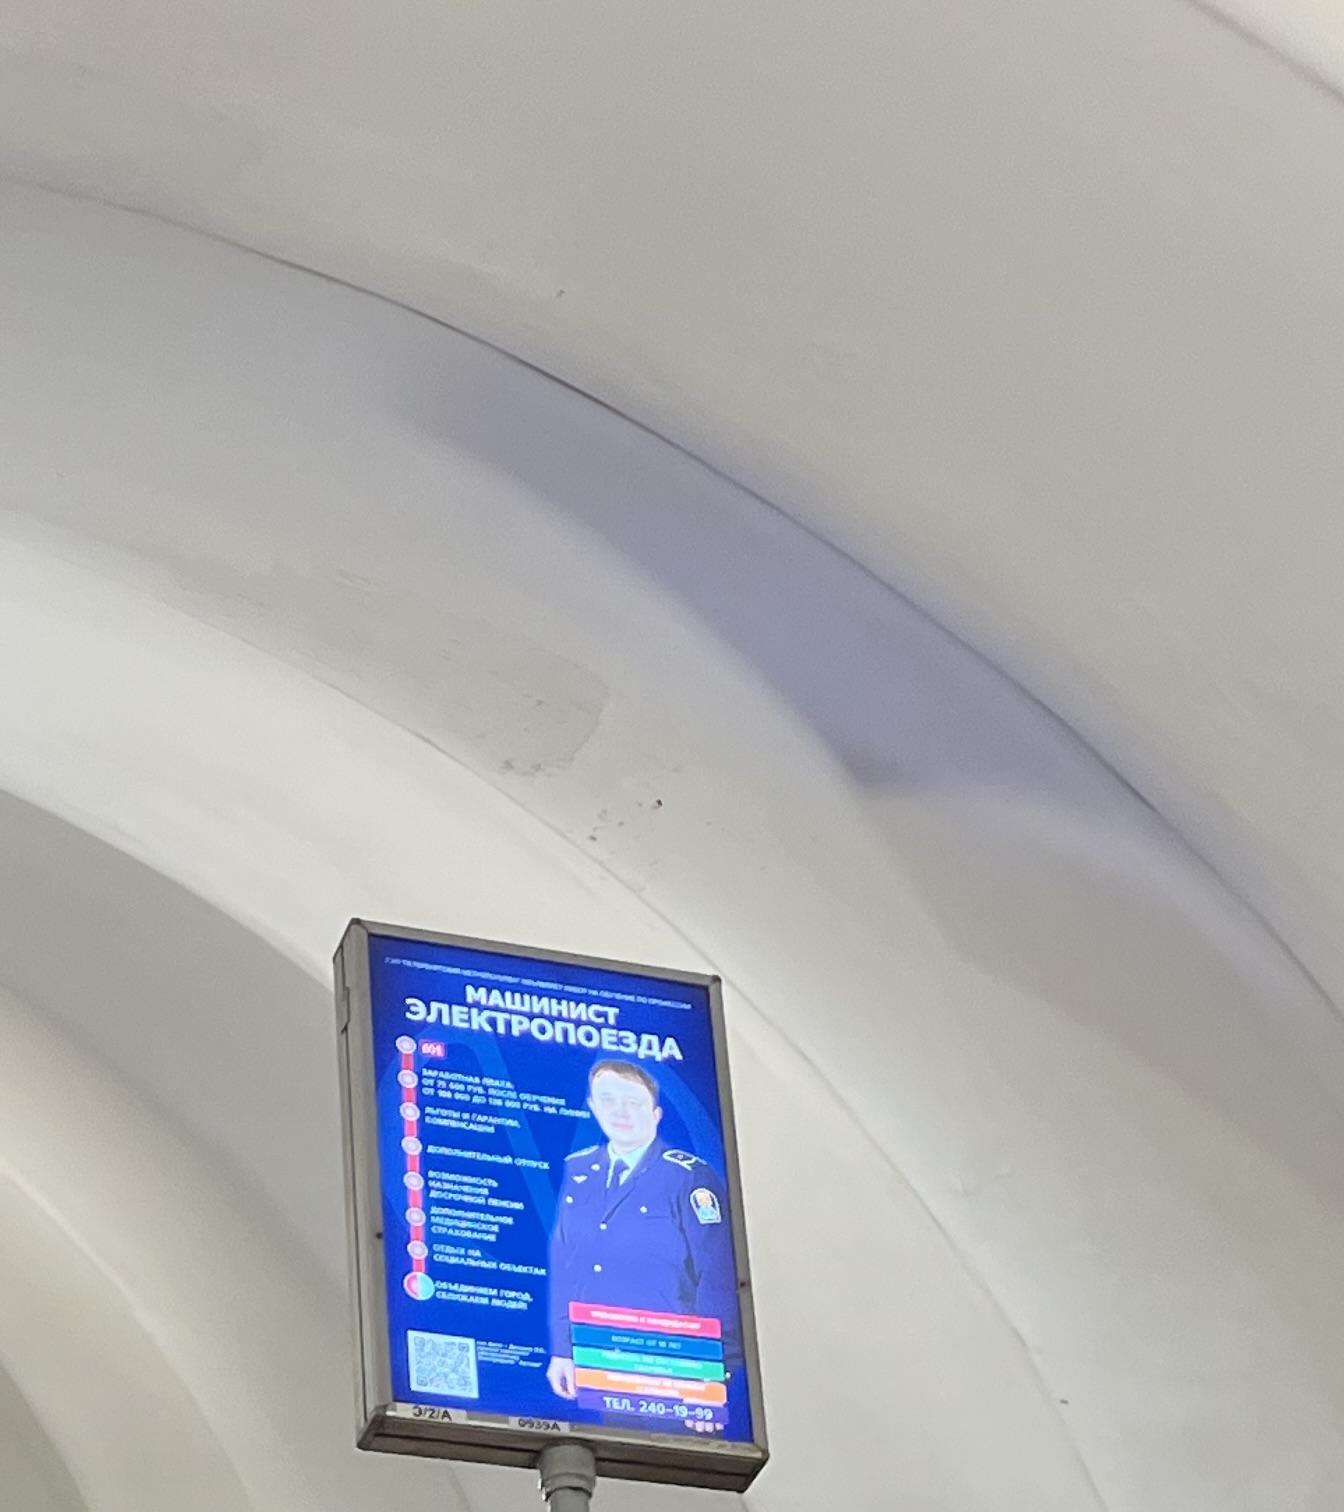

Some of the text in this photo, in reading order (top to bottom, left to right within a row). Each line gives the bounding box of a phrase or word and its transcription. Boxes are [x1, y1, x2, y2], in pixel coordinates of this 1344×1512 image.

[465, 984, 621, 1026] МАШИНИСТ
[404, 998, 684, 1062] ЭЛЕКТРОПОЕЗДА
[603, 1396, 714, 1420] ТЕЛ. 240-19-99
